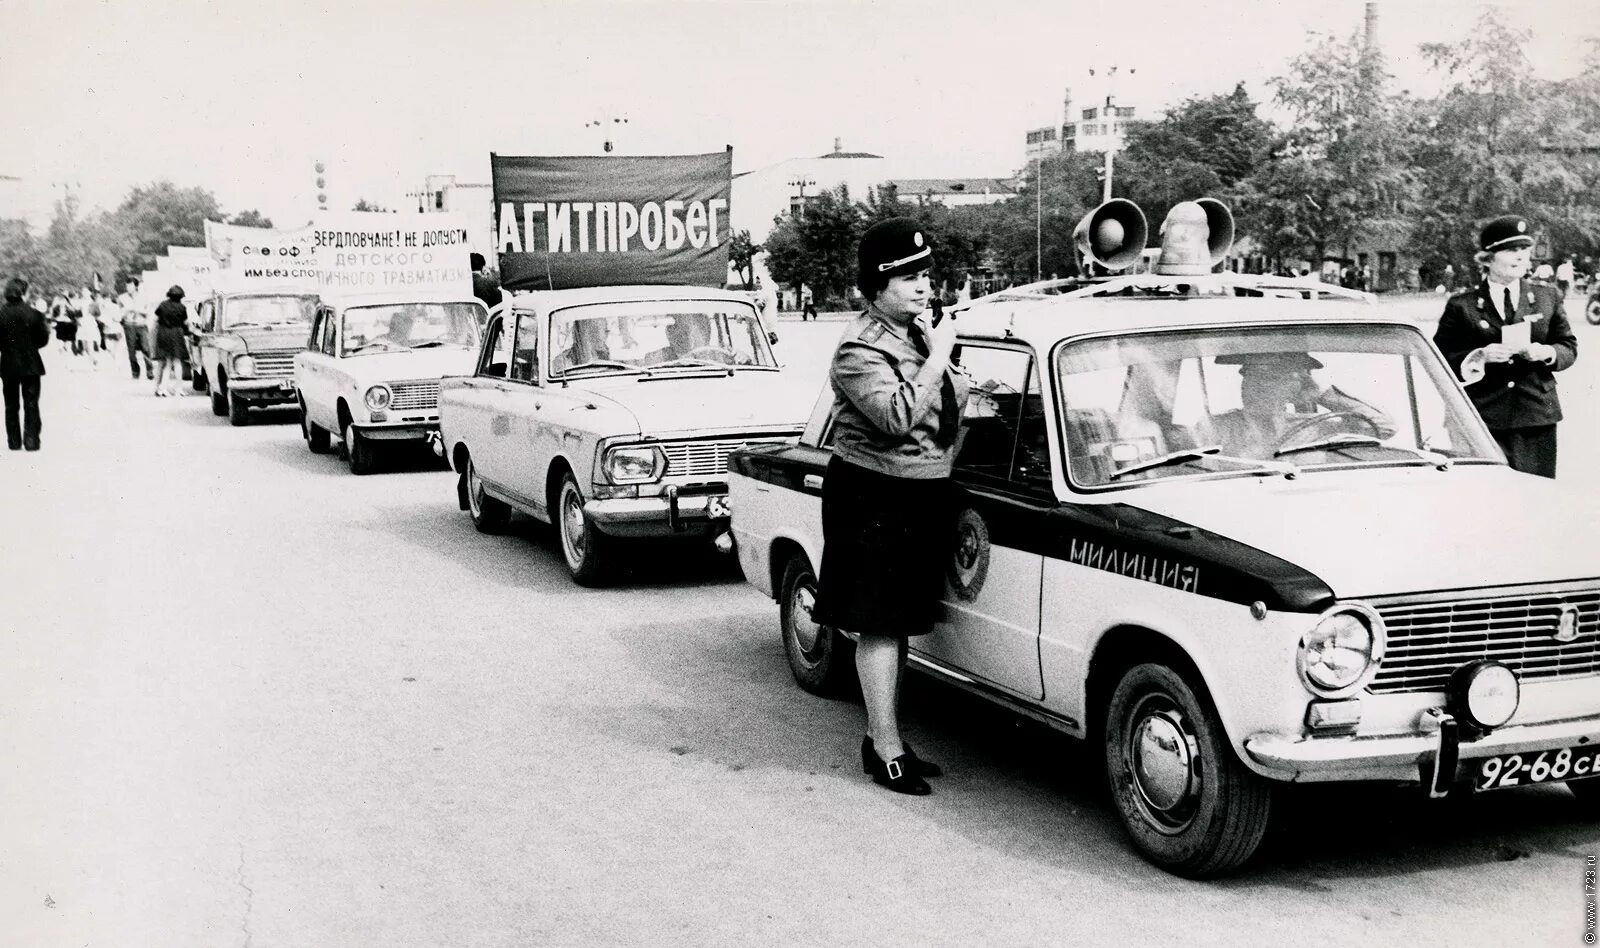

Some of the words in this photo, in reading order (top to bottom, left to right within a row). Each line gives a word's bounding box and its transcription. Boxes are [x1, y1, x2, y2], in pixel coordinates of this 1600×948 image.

[314, 230, 401, 249] ВЕРДЛОВЧАНЕ!
[404, 231, 418, 247] НЕ
[336, 252, 433, 267] ДЕТСКОГО
[291, 268, 316, 278] СПО
[1069, 537, 1200, 594] МИЛИЦИЯ
